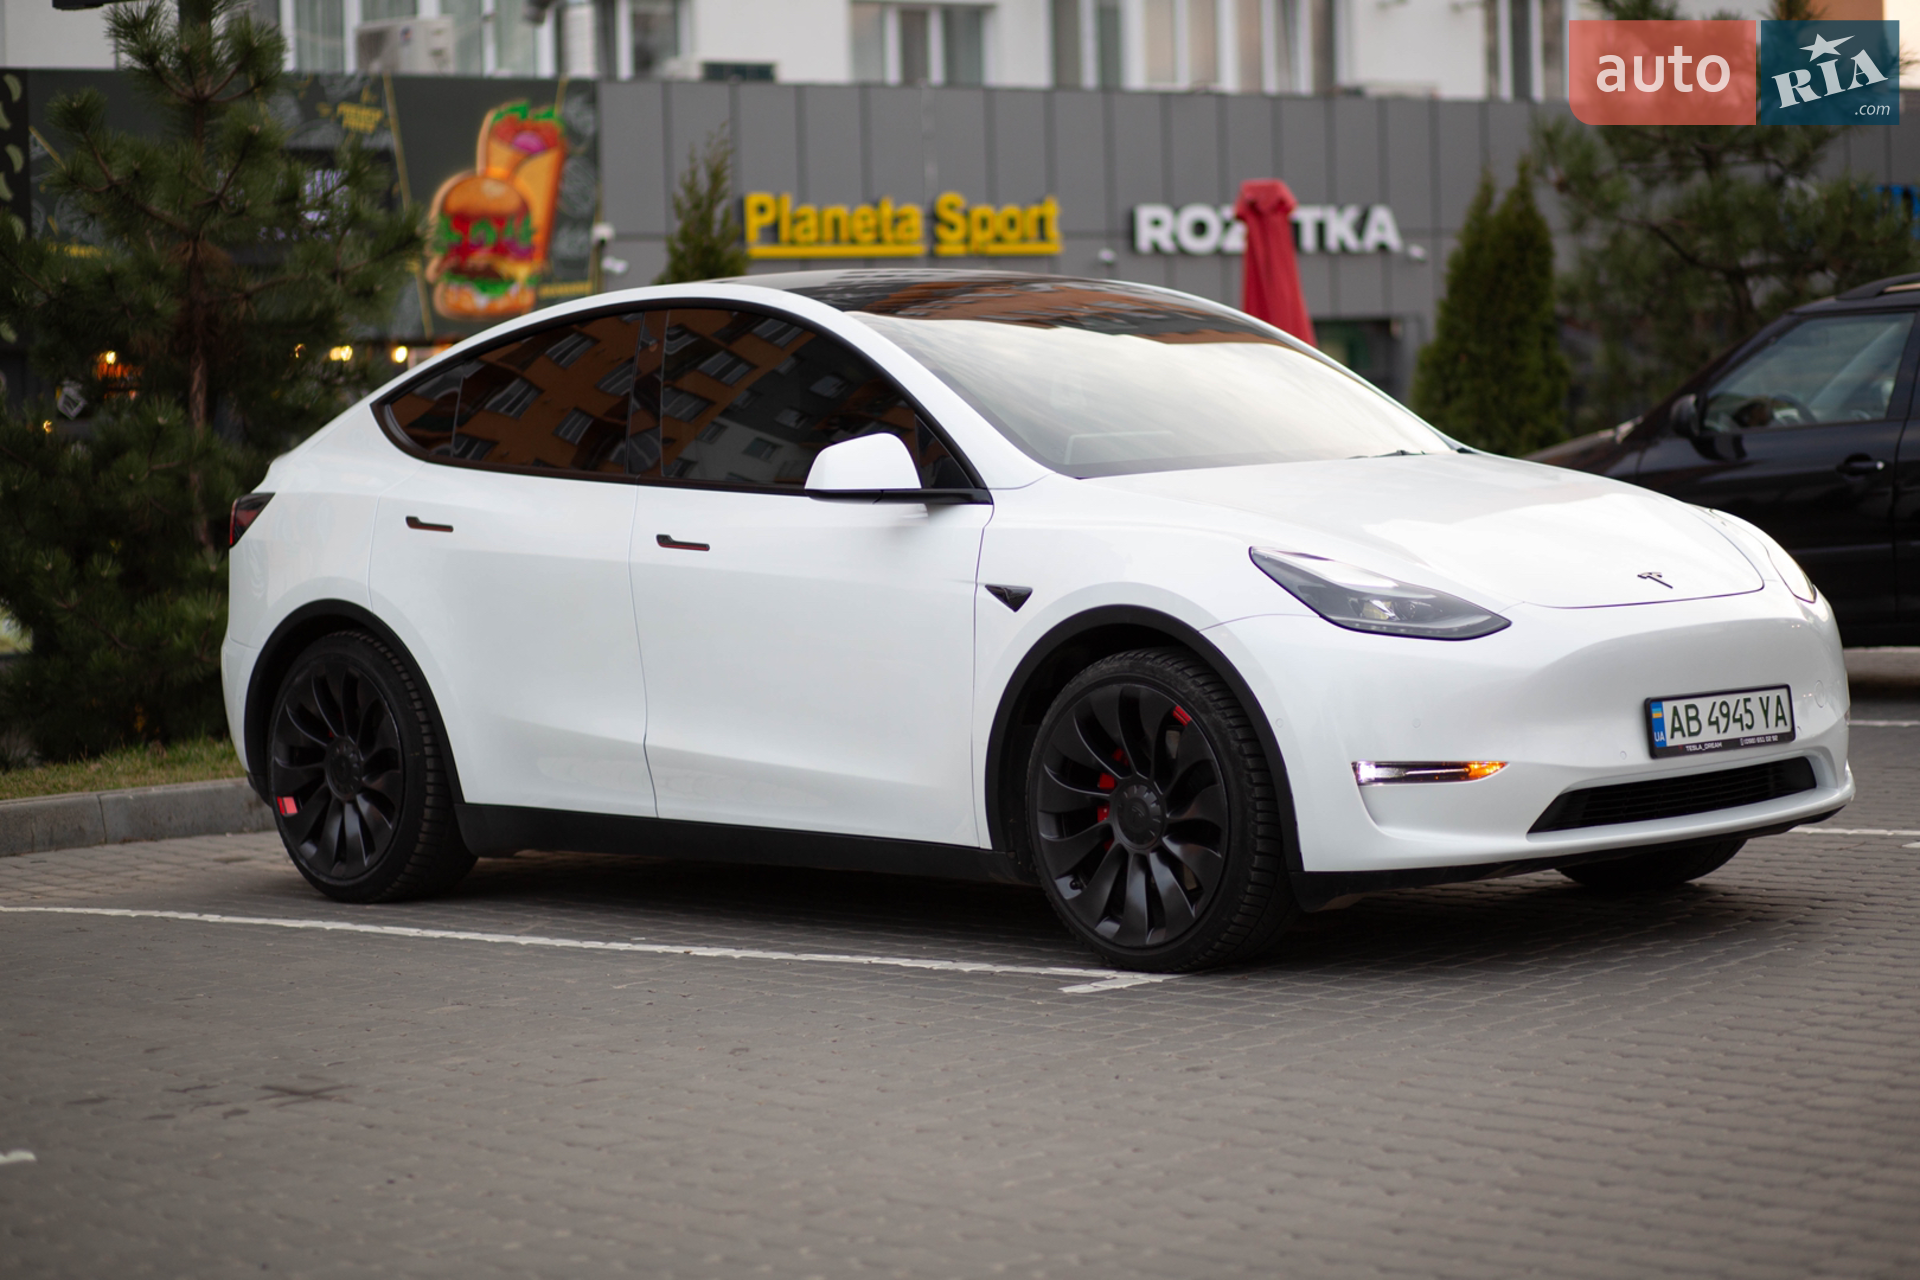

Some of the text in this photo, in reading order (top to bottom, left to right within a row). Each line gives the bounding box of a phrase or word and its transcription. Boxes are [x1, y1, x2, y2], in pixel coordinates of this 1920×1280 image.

[745, 191, 1061, 253] Planeta Sport
[1135, 203, 1402, 254] ROZTKA
[1654, 731, 1666, 742] UA
[1670, 694, 1788, 739] AB 4945 YA
